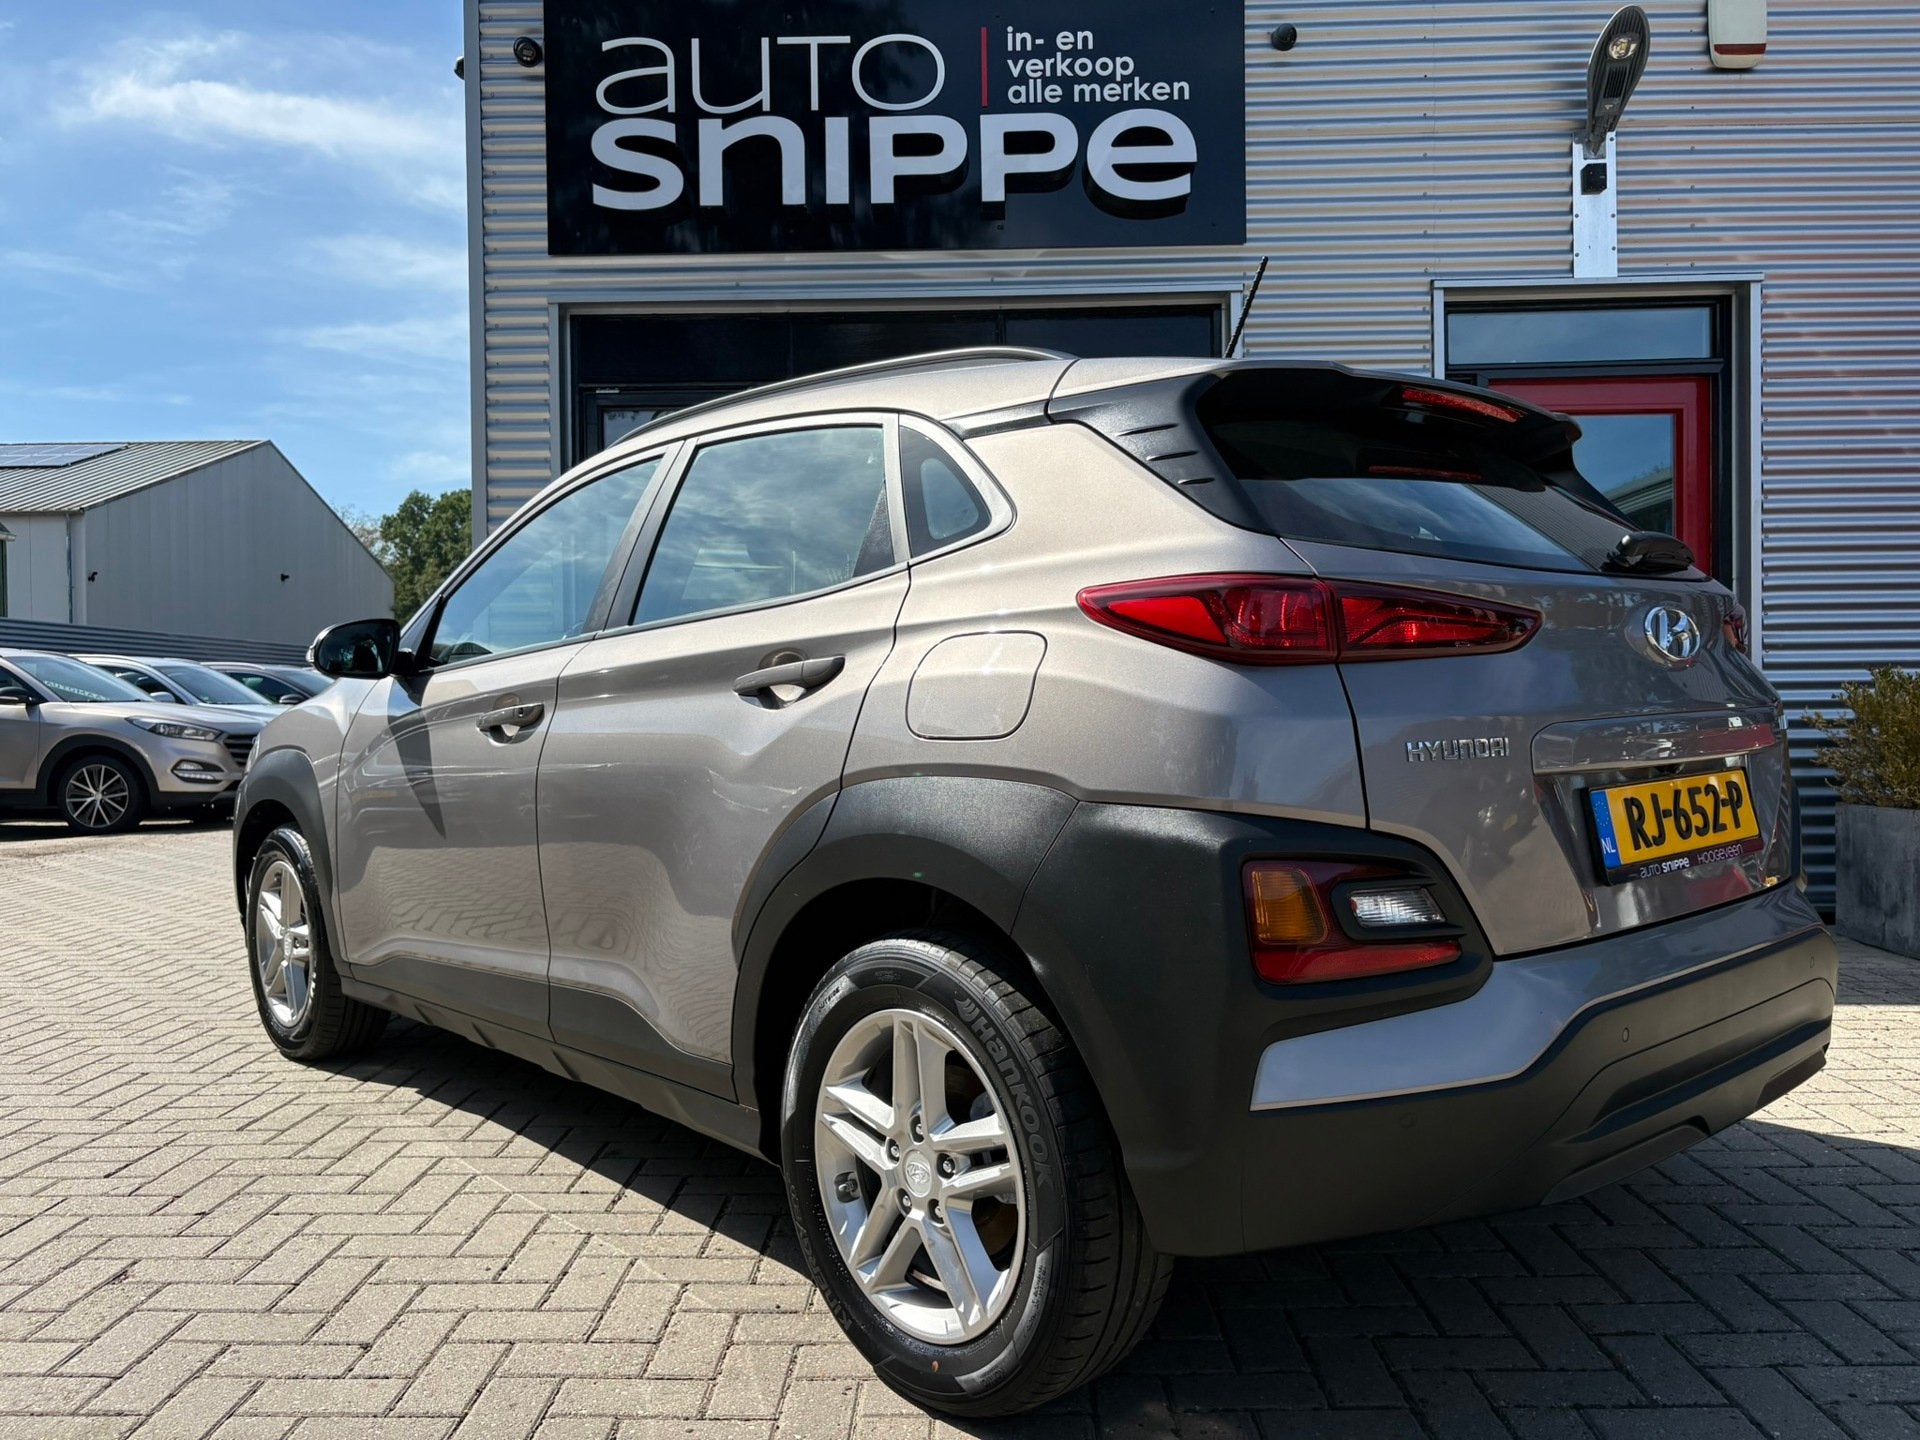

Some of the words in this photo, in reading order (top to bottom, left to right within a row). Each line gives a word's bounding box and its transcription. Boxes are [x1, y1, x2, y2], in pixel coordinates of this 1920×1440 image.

[1007, 26, 1045, 51] in-
[1056, 30, 1094, 51] en
[1007, 52, 1135, 82] verkoop
[1007, 78, 1063, 104] alle
[1073, 76, 1191, 102] merken
[1406, 737, 1510, 761] HYUNDAI
[1623, 780, 1743, 851] RJ-652-P
[1601, 837, 1617, 855] NL
